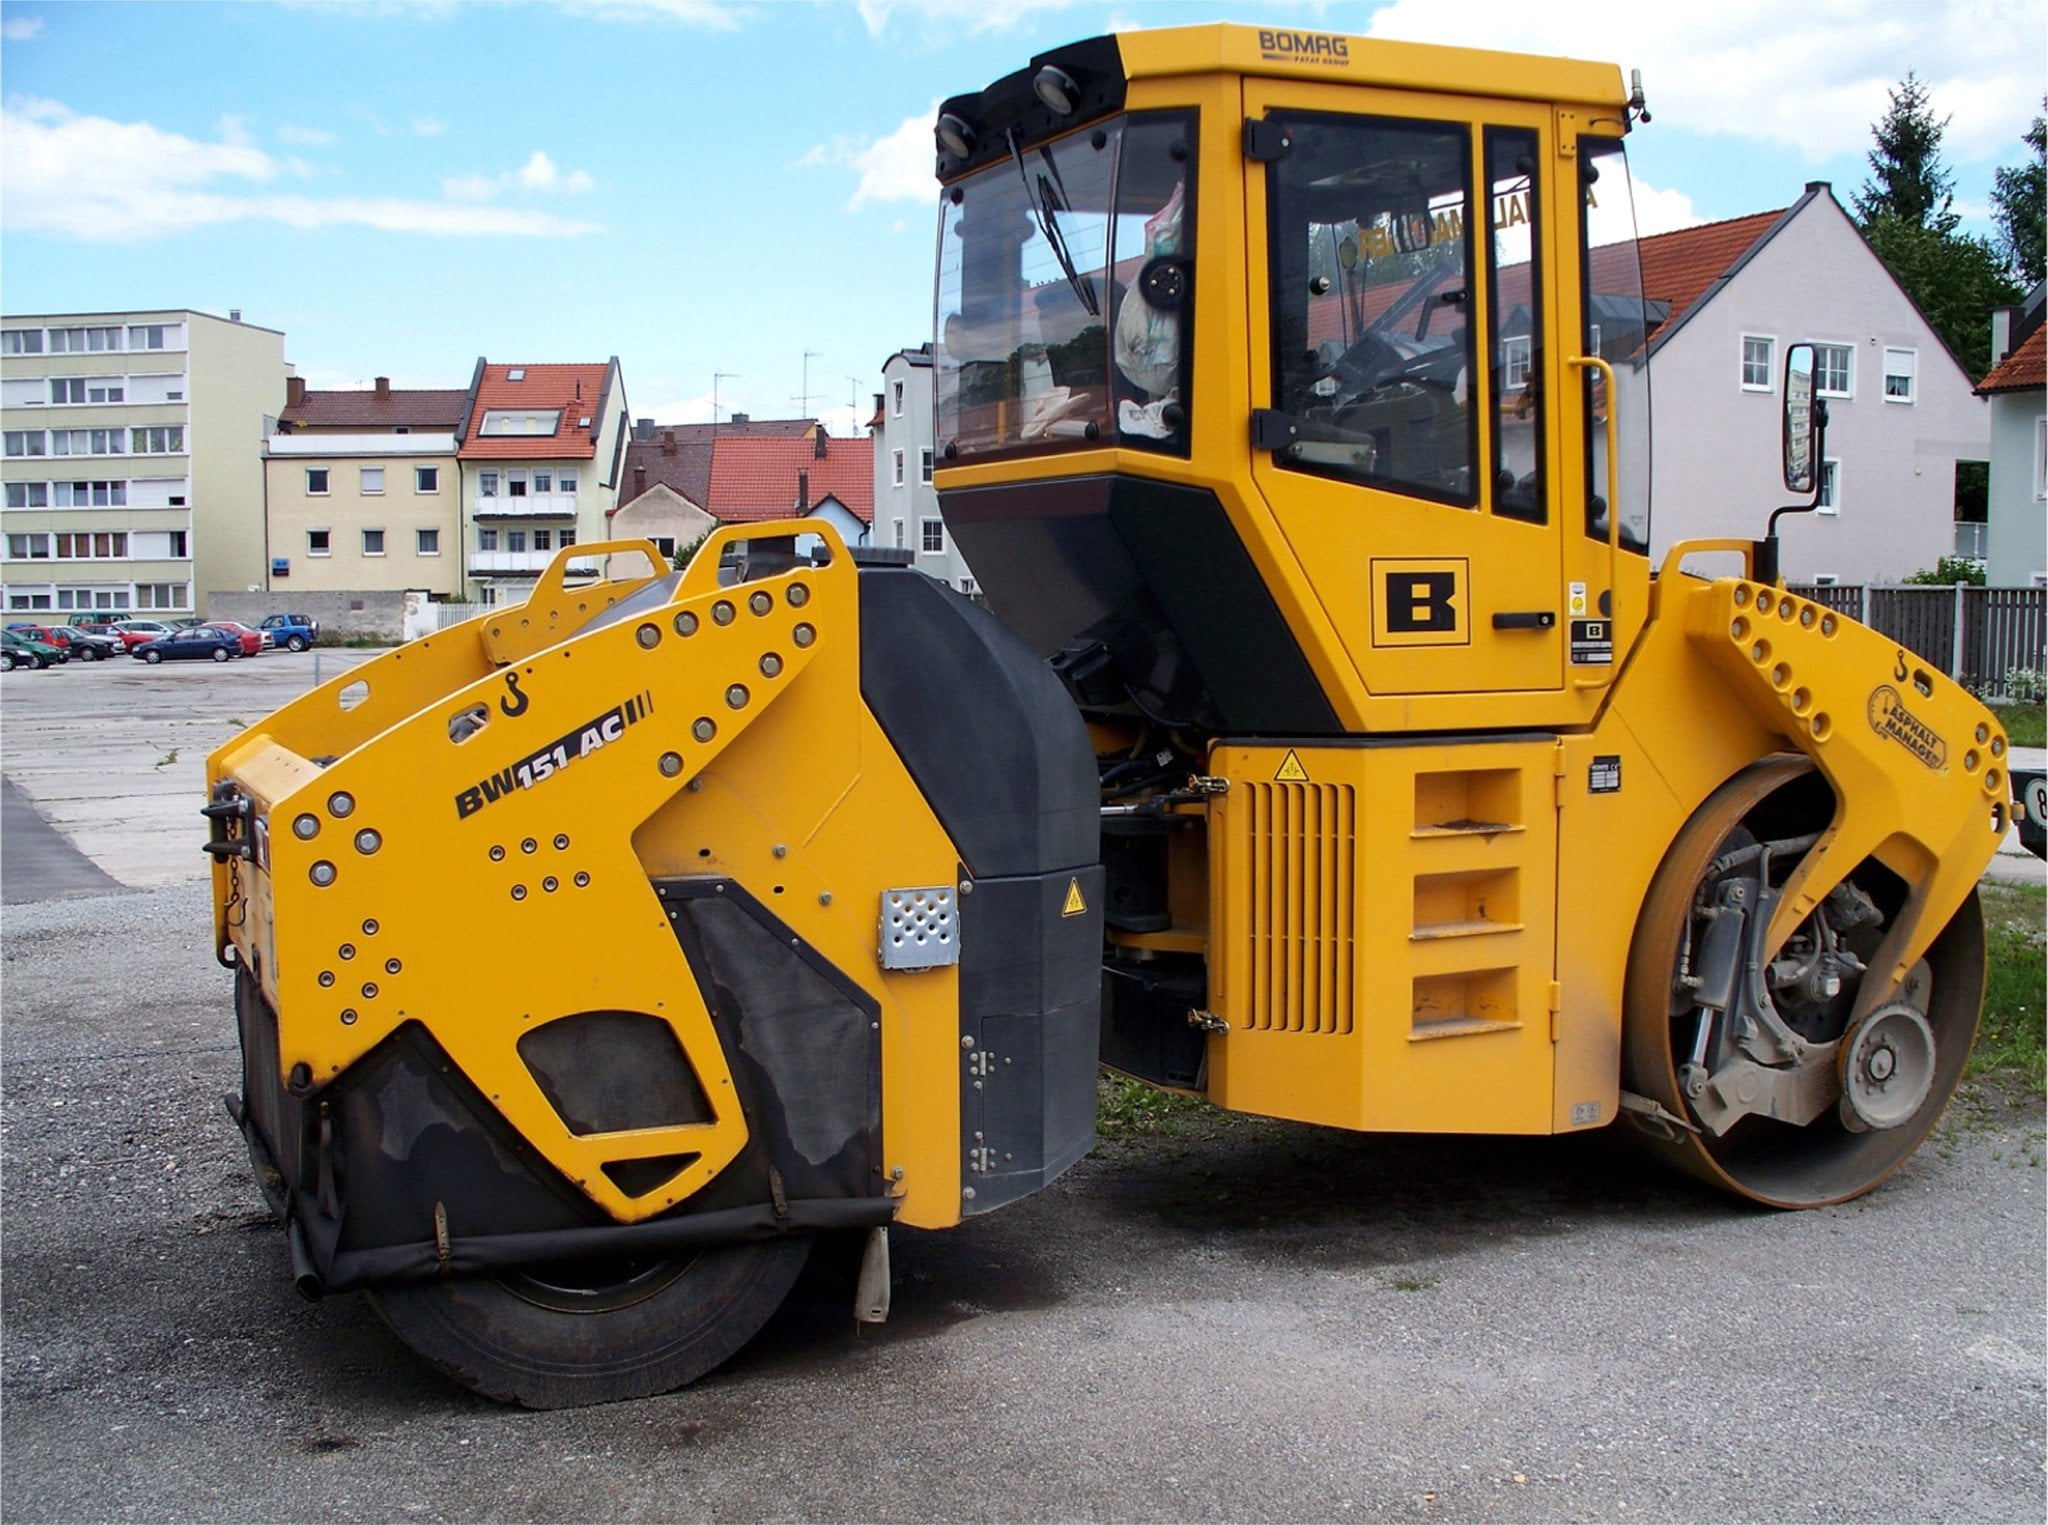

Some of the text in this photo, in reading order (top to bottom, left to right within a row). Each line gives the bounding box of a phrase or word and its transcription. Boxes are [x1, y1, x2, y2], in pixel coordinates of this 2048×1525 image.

[1259, 30, 1348, 56] BOMAG
[1386, 572, 1455, 633] B
[580, 714, 623, 758] AC
[1890, 706, 1937, 748] ASPHALT
